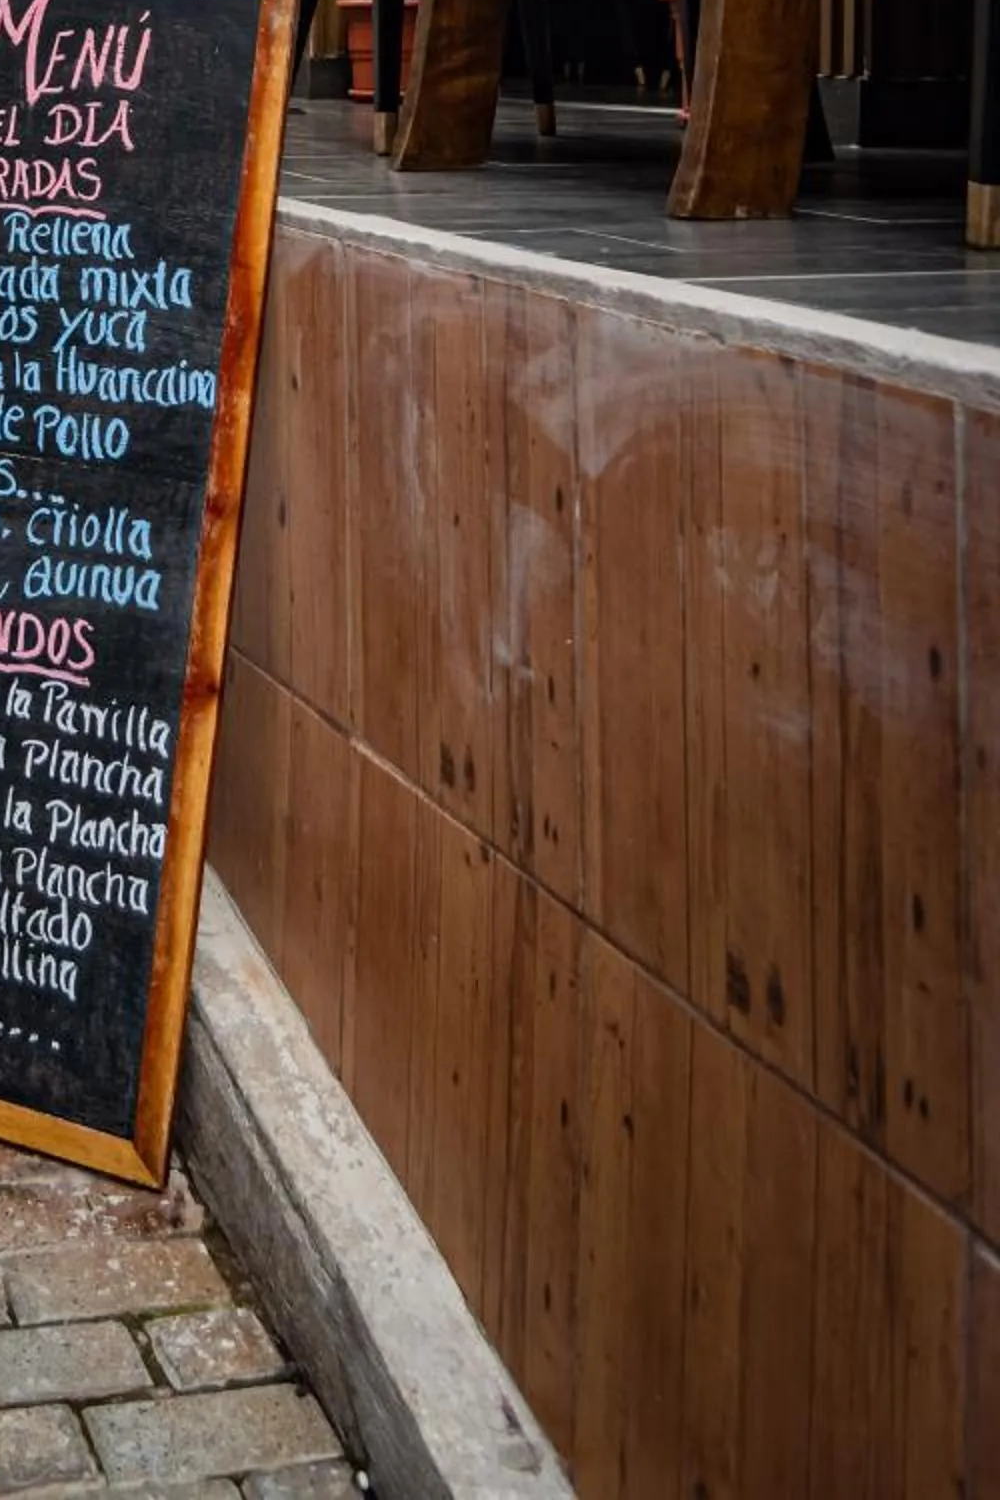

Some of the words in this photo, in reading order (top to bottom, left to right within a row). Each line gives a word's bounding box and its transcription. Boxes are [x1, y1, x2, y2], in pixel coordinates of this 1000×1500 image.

[4, 211, 135, 260] Rellena
[80, 261, 193, 311] mixta
[13, 350, 42, 393] la
[34, 404, 131, 460] Pollo
[5, 677, 32, 720] la
[40, 681, 171, 758] Parrilla
[21, 739, 164, 805] Plancha
[4, 786, 32, 835] la
[46, 800, 167, 859] Plancha
[11, 846, 149, 915] Plancha
